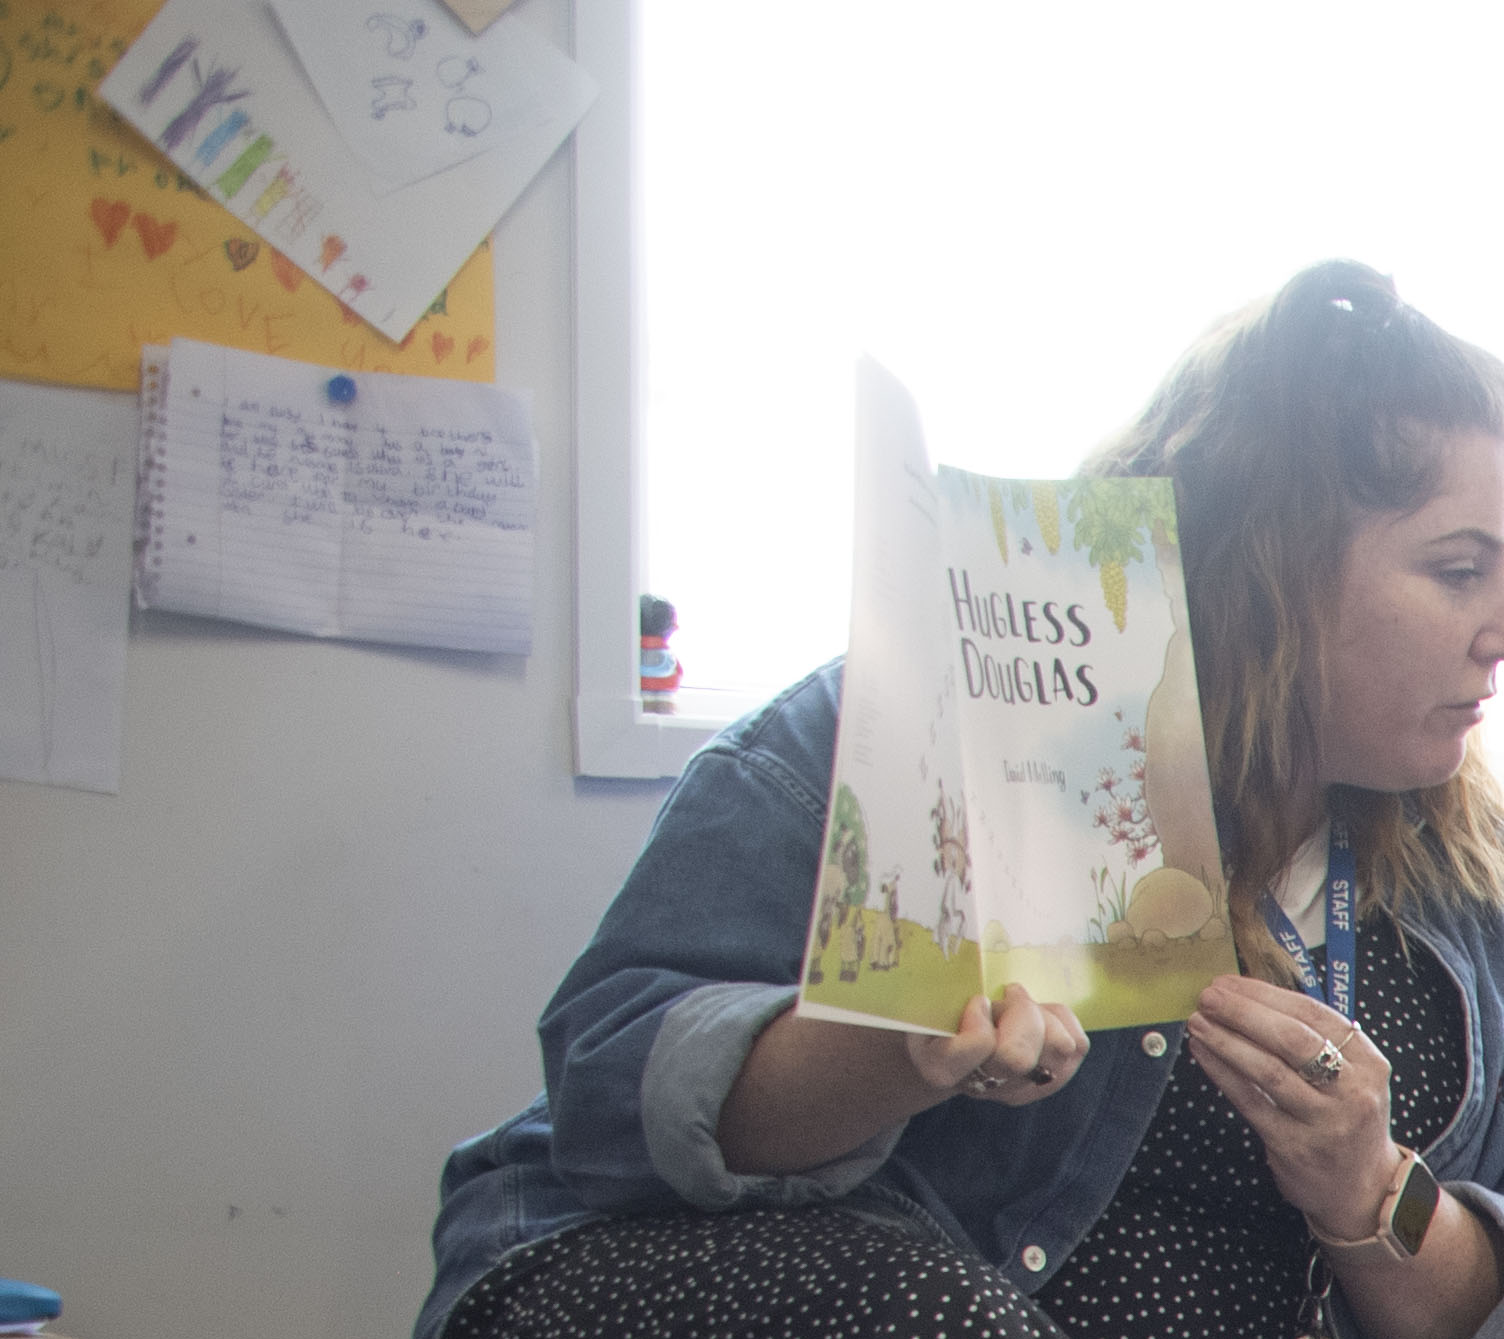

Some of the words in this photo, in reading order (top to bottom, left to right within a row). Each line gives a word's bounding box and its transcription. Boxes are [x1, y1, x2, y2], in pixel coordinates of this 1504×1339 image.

[1332, 879, 1350, 932] STAFF
[1279, 931, 1316, 989] STAFF
[1332, 960, 1350, 1015] STAFF
